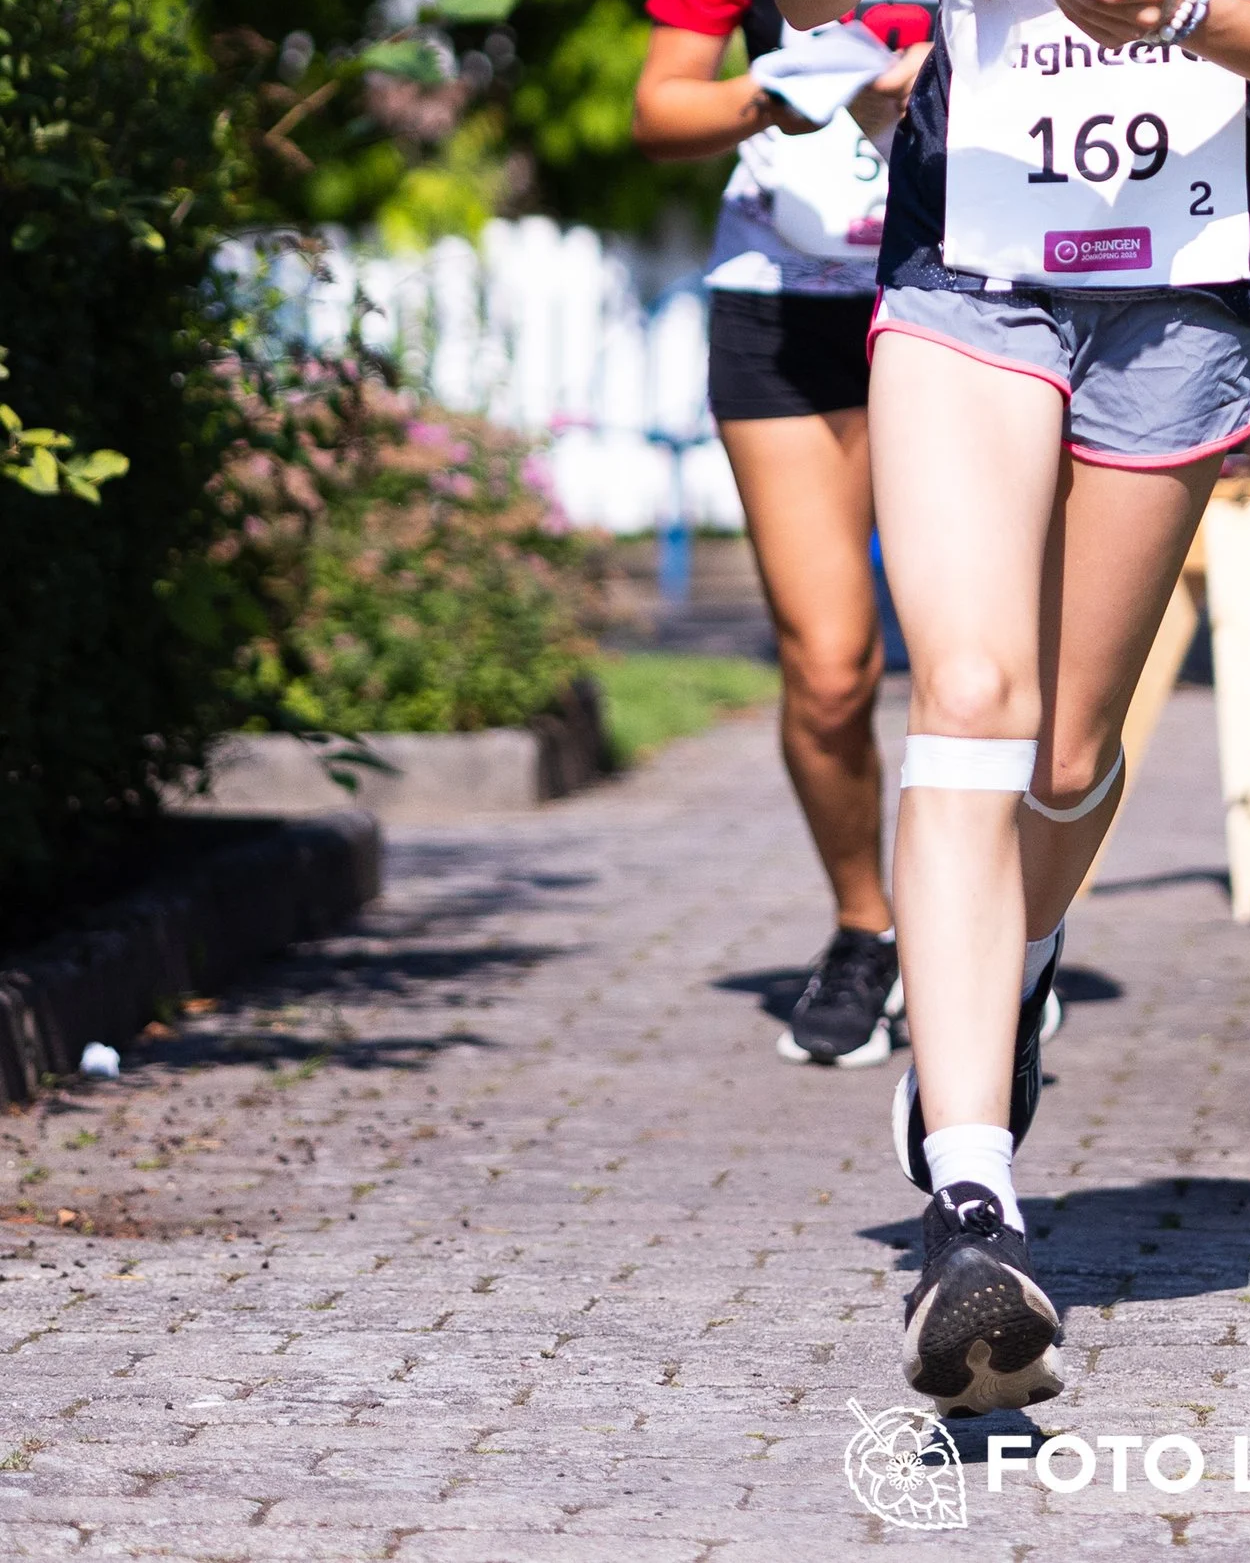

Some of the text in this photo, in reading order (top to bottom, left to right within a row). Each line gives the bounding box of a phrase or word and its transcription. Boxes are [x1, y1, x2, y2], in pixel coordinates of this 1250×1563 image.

[1028, 112, 1169, 184] 169
[1189, 180, 1214, 216] 2
[1080, 239, 1141, 253] O-RINGEN
